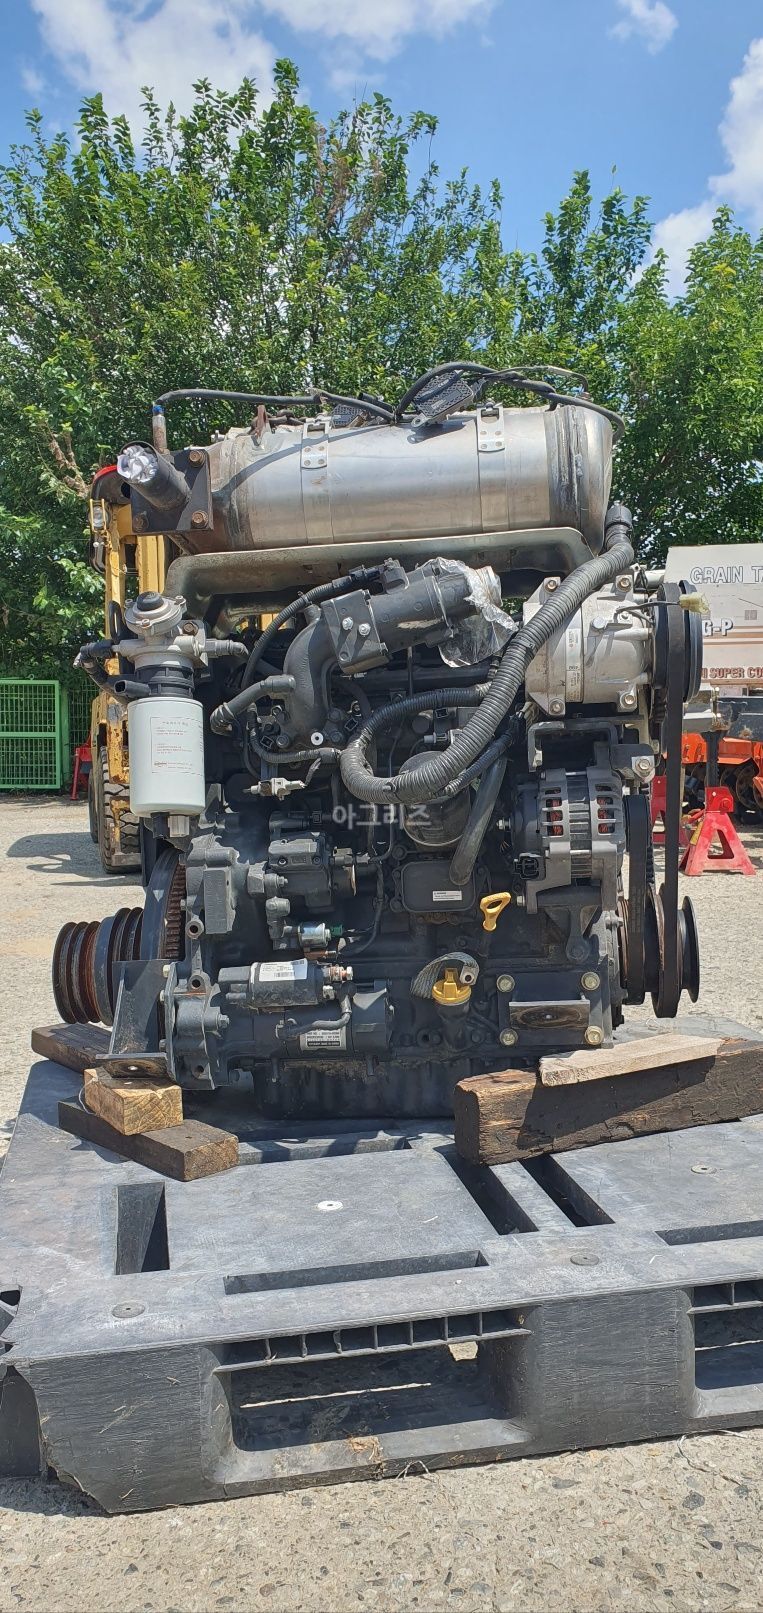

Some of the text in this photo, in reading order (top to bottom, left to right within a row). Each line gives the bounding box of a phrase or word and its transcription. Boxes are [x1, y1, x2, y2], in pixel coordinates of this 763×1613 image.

[690, 565, 763, 584] GRAIN T
[709, 667, 744, 678] SUPER
